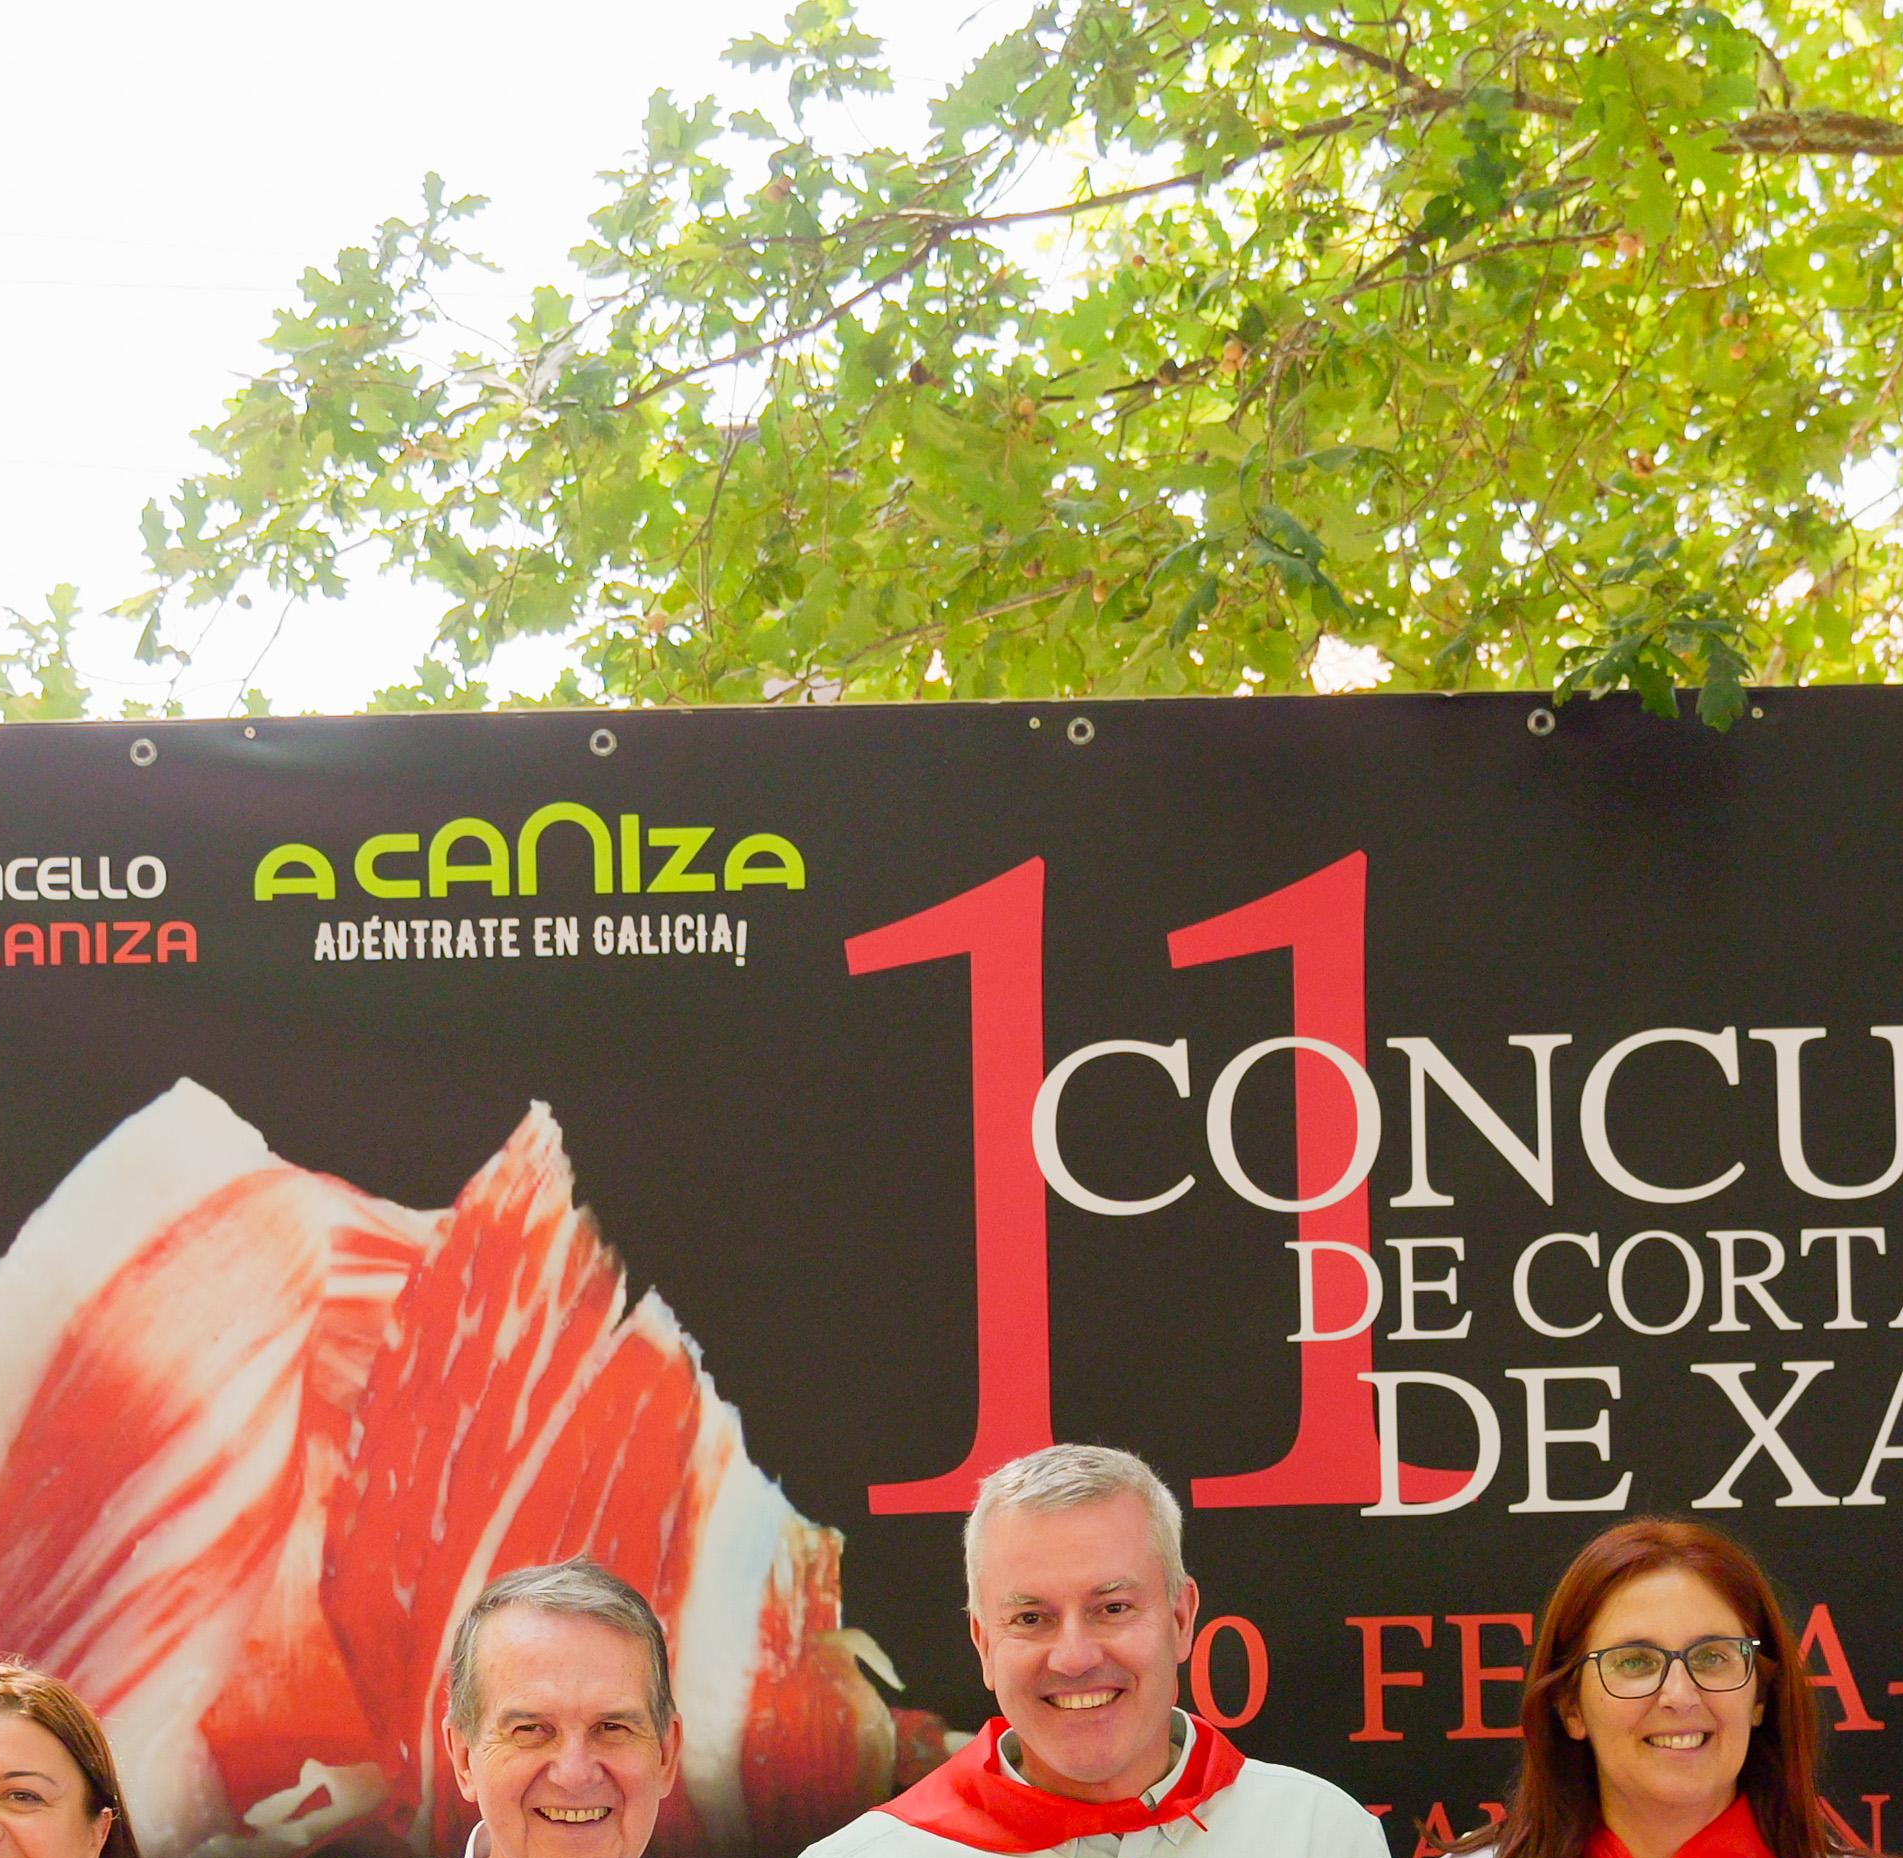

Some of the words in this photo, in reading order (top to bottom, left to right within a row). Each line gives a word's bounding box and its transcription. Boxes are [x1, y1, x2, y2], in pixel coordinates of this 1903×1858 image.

[254, 844, 335, 901] A
[314, 915, 521, 961] ADÉNTRATE
[533, 916, 580, 957] EN
[592, 913, 748, 967] GALICIA!
[844, 848, 1475, 1515] 11
[1284, 1237, 1473, 1342] DE
[1358, 1366, 1633, 1517] DE
